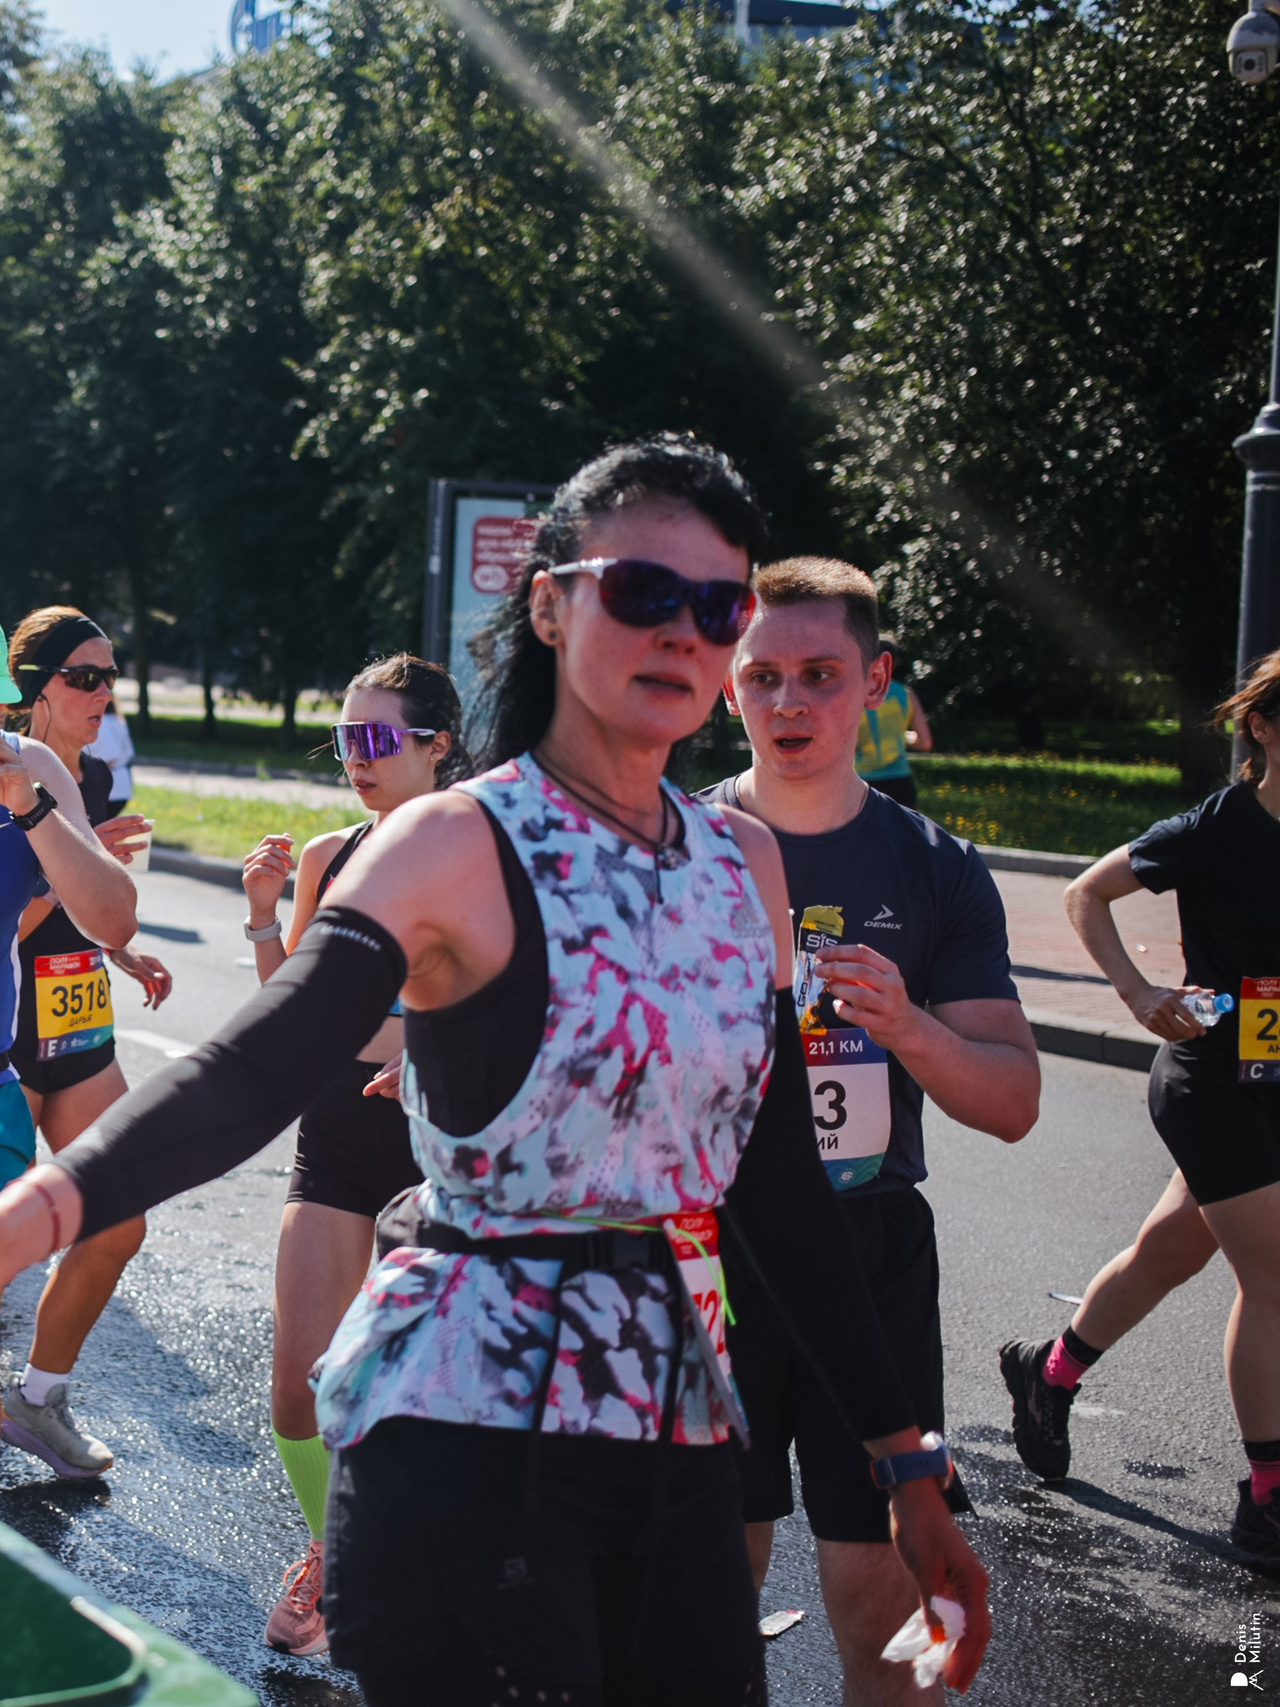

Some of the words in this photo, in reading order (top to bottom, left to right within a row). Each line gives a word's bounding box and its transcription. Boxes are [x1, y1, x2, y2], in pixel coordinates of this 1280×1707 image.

[863, 921, 903, 930] DEMIX
[52, 979, 107, 1017] 3518
[1256, 1008, 1280, 1041] 2
[47, 1039, 58, 1057] E
[809, 1041, 834, 1056] 21,1
[839, 1040, 863, 1053] КМ
[1250, 1063, 1264, 1079] C
